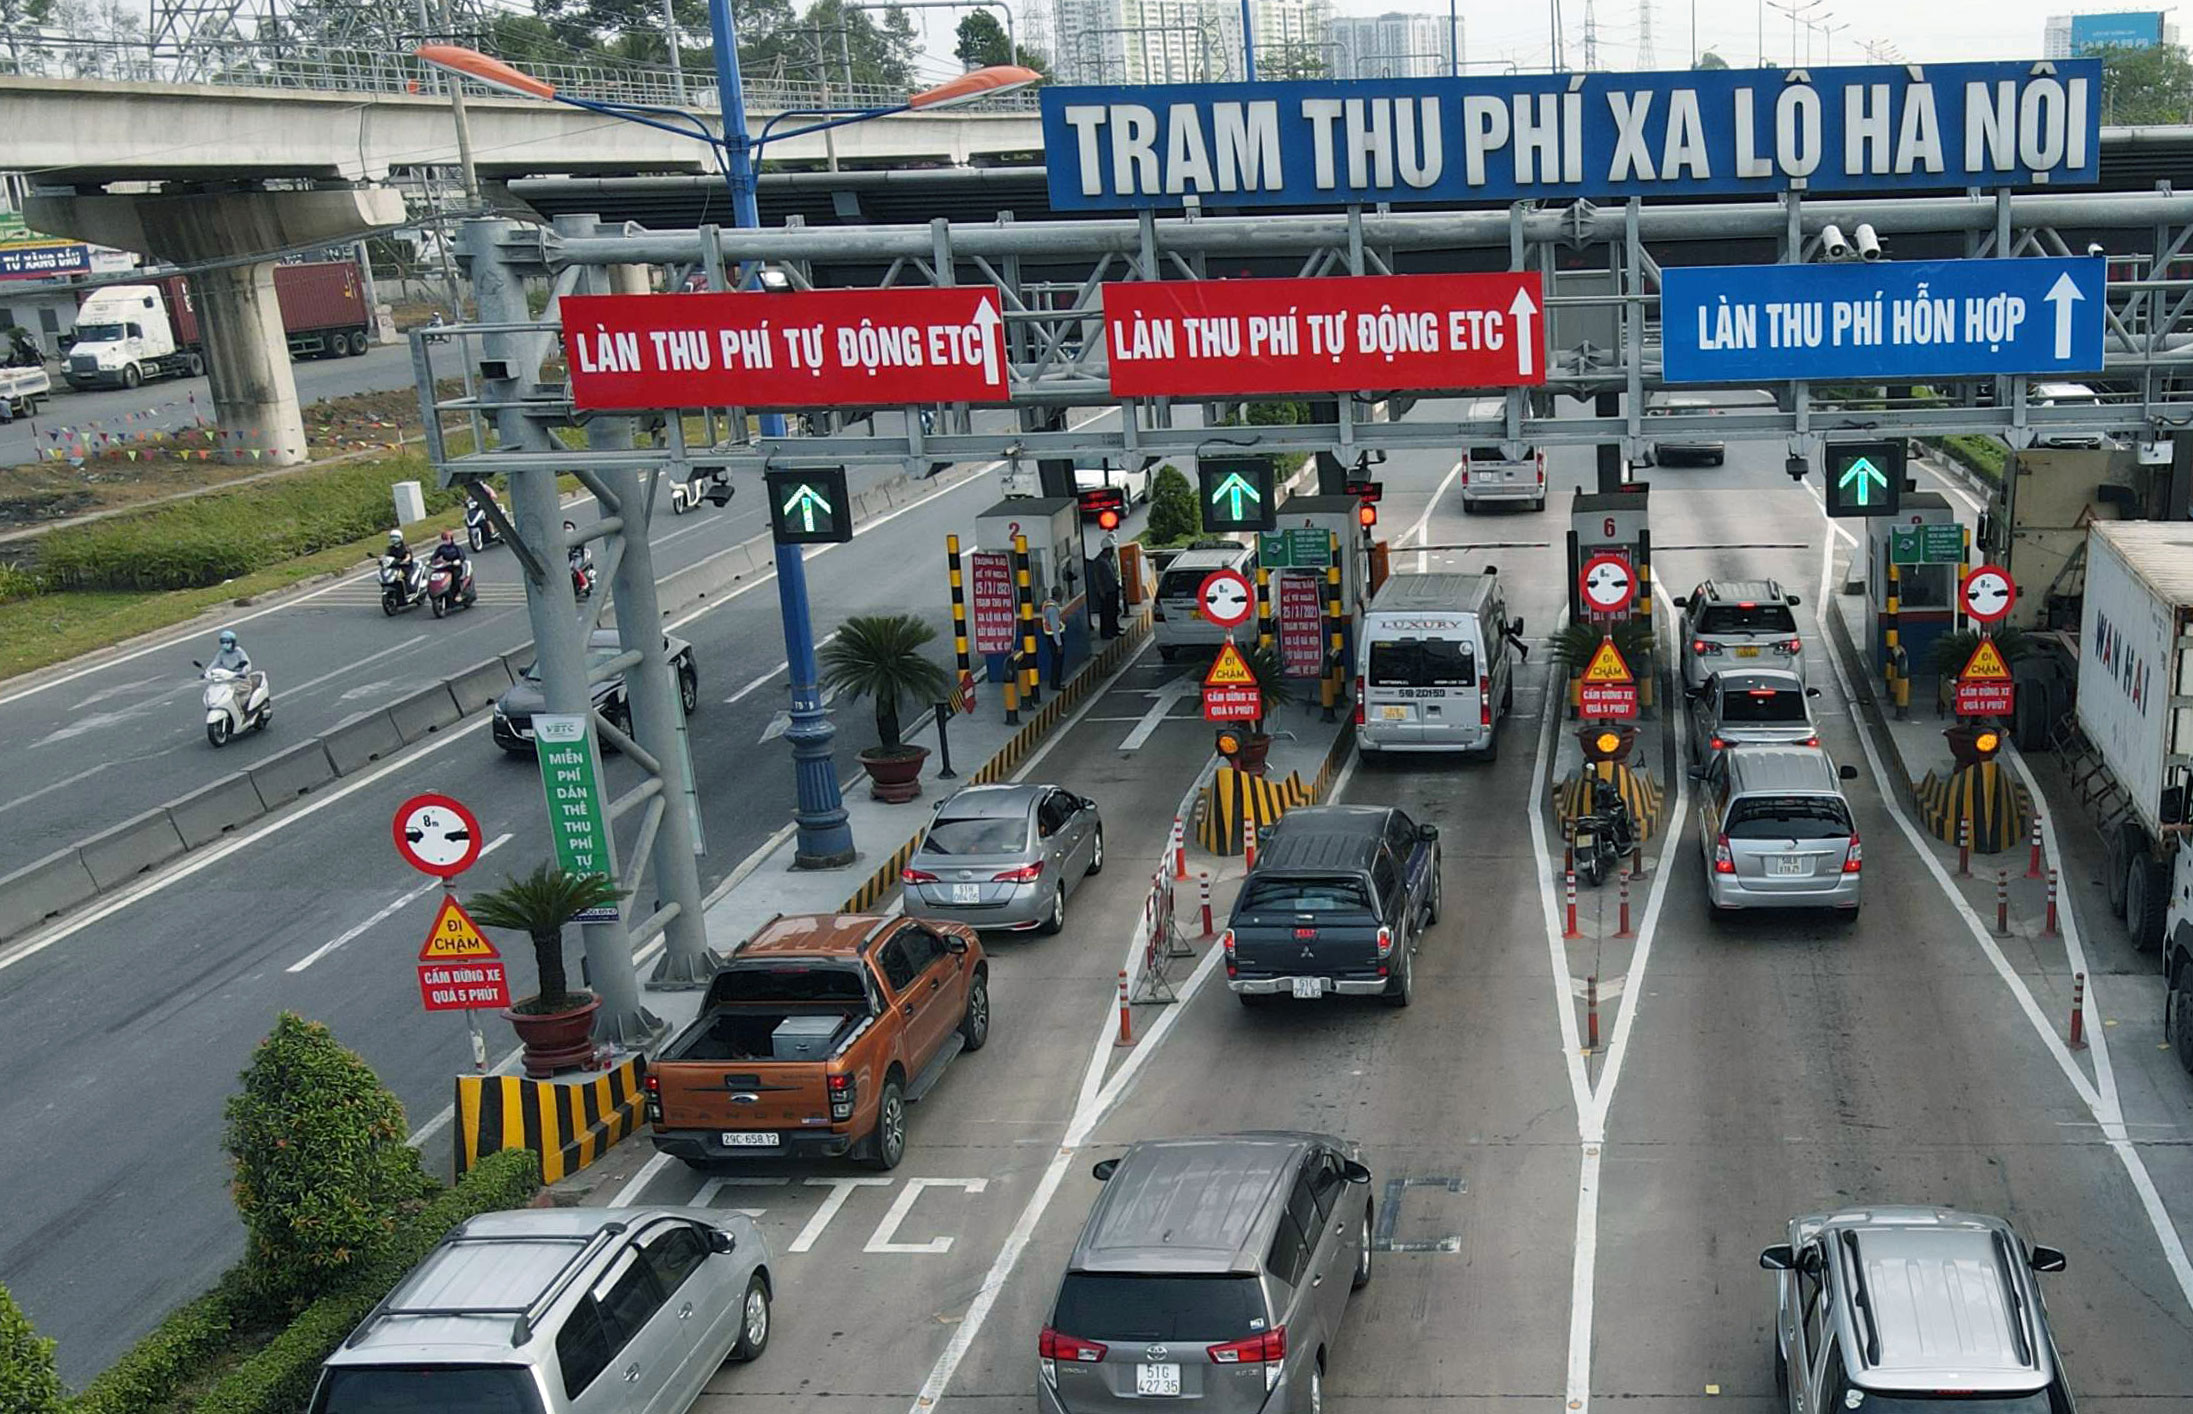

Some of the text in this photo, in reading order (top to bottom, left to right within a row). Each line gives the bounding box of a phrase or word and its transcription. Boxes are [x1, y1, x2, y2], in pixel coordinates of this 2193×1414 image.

[1065, 61, 2088, 207] TRẠM THU PHÍ XA LỘ HÀ NỘI
[1698, 282, 2026, 353] LÀN THU PHÍ HỖN HỢP
[1113, 304, 1504, 363] LÀN THU PHÍ TỰ ĐỘNG ETC
[576, 318, 982, 376] LÀN THU PHÍ TỰ ĐỘNG ETC
[1604, 517, 1616, 538] 6
[1381, 620, 1462, 631] LUXURY
[2095, 608, 2150, 718] WAN HAI
[549, 748, 583, 765] MIỄN
[557, 768, 581, 782] PHÍ
[557, 785, 587, 799] DÁN
[564, 821, 591, 833] THU
[569, 835, 593, 850] PHÍ
[575, 855, 593, 869] TỰ
[447, 919, 463, 932] ĐI
[435, 936, 480, 953] CHẬM
[425, 968, 450, 984] CẤM
[486, 969, 501, 982] XE
[432, 985, 499, 1005] QUÁ 5 PHÚT
[1147, 1366, 1170, 1379] 51G
